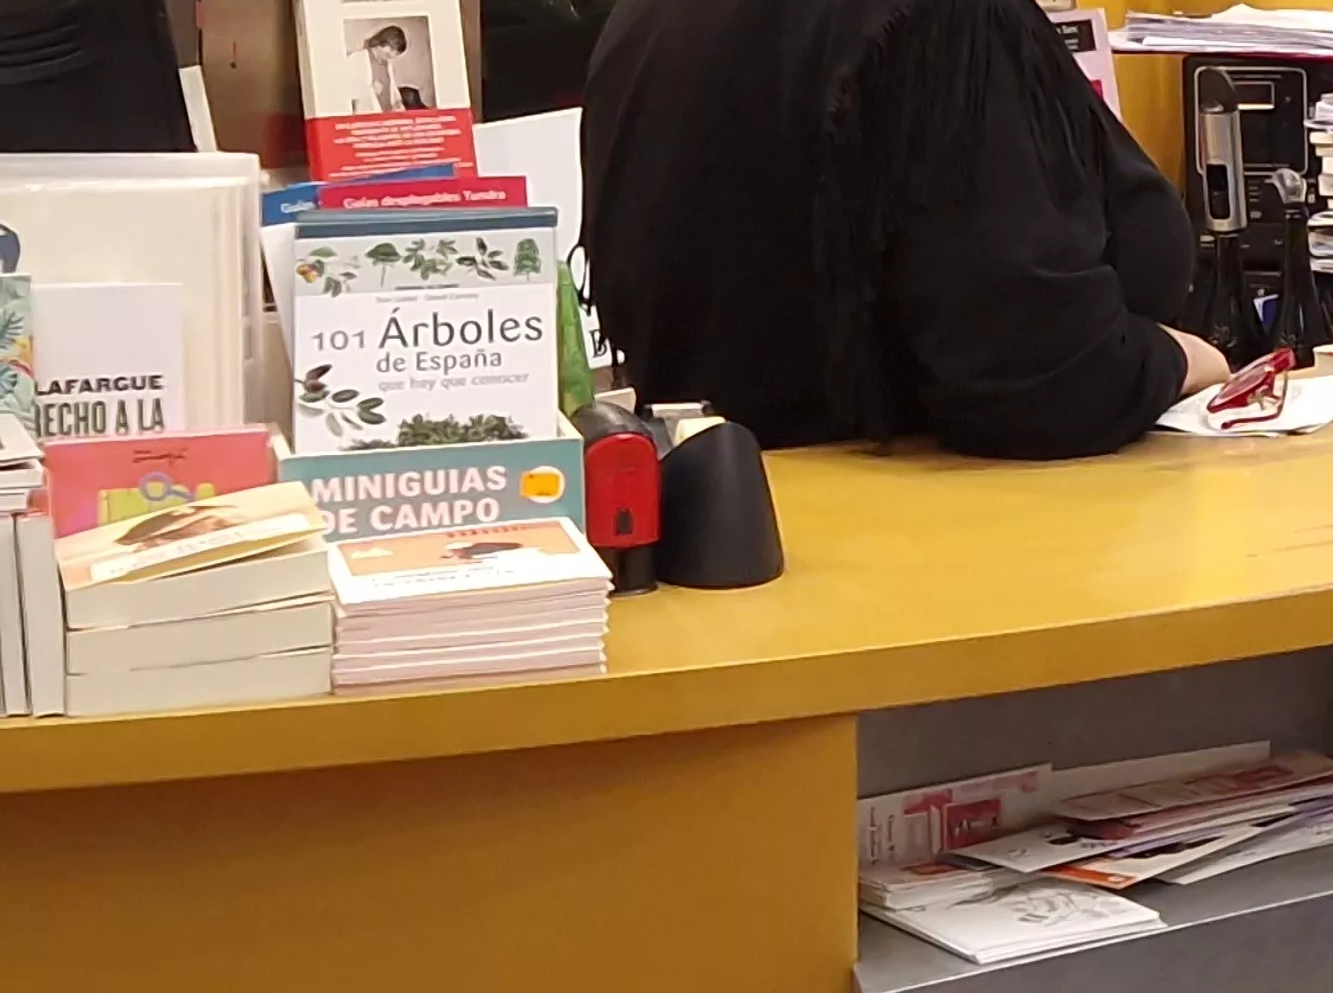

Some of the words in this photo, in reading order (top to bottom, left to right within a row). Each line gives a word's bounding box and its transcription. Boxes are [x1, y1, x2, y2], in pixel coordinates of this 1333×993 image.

[343, 197, 379, 209] Guías
[312, 329, 366, 352] 101
[378, 307, 543, 350] Árboles
[376, 351, 407, 373] de
[416, 348, 502, 375] España
[35, 374, 165, 396] LAFARGUE
[378, 377, 405, 392] que
[410, 375, 437, 392] hay
[441, 376, 467, 390] que
[471, 372, 530, 385] conocer
[115, 399, 130, 435] A
[137, 397, 166, 434] LA
[311, 465, 508, 505] MINIGUIAS
[320, 510, 357, 537] DE
[370, 499, 501, 533] CAMPO
